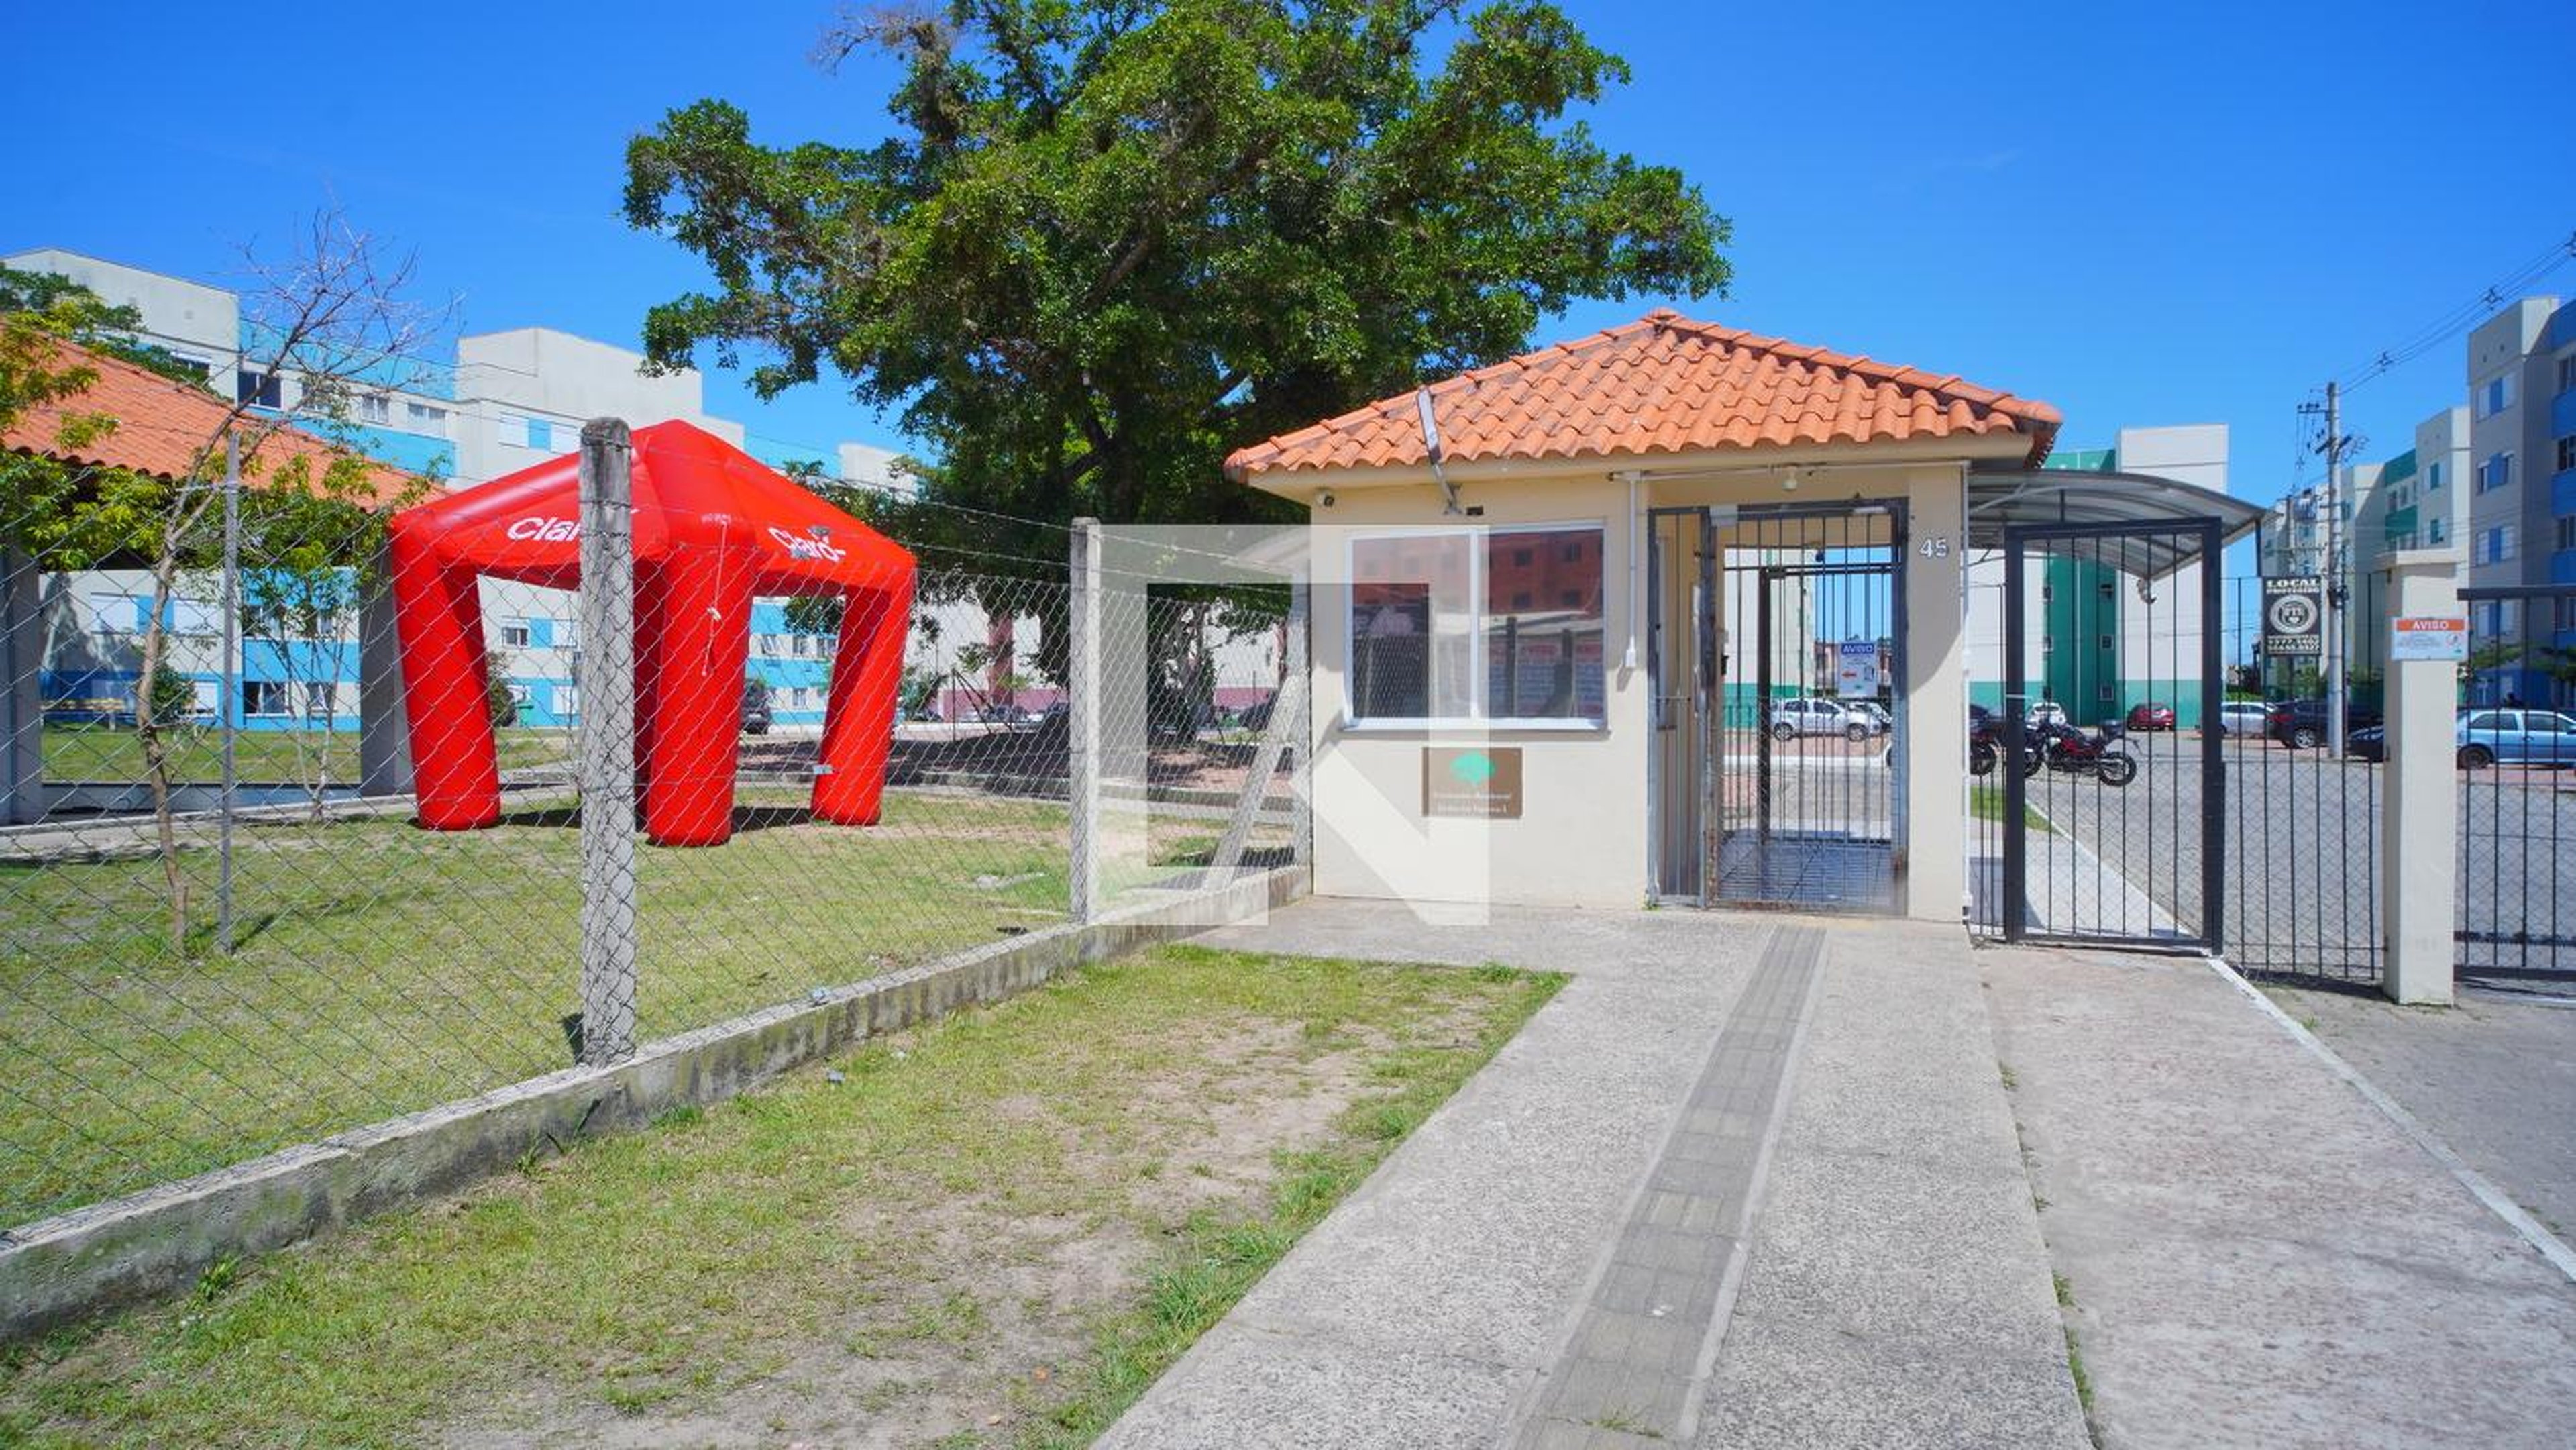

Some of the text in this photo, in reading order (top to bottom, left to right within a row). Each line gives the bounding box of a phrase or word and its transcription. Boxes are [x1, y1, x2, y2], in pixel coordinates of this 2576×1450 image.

[1919, 539, 1947, 557] 45
[2266, 578, 2320, 588] LOCAL
[2413, 620, 2449, 630] AVISO
